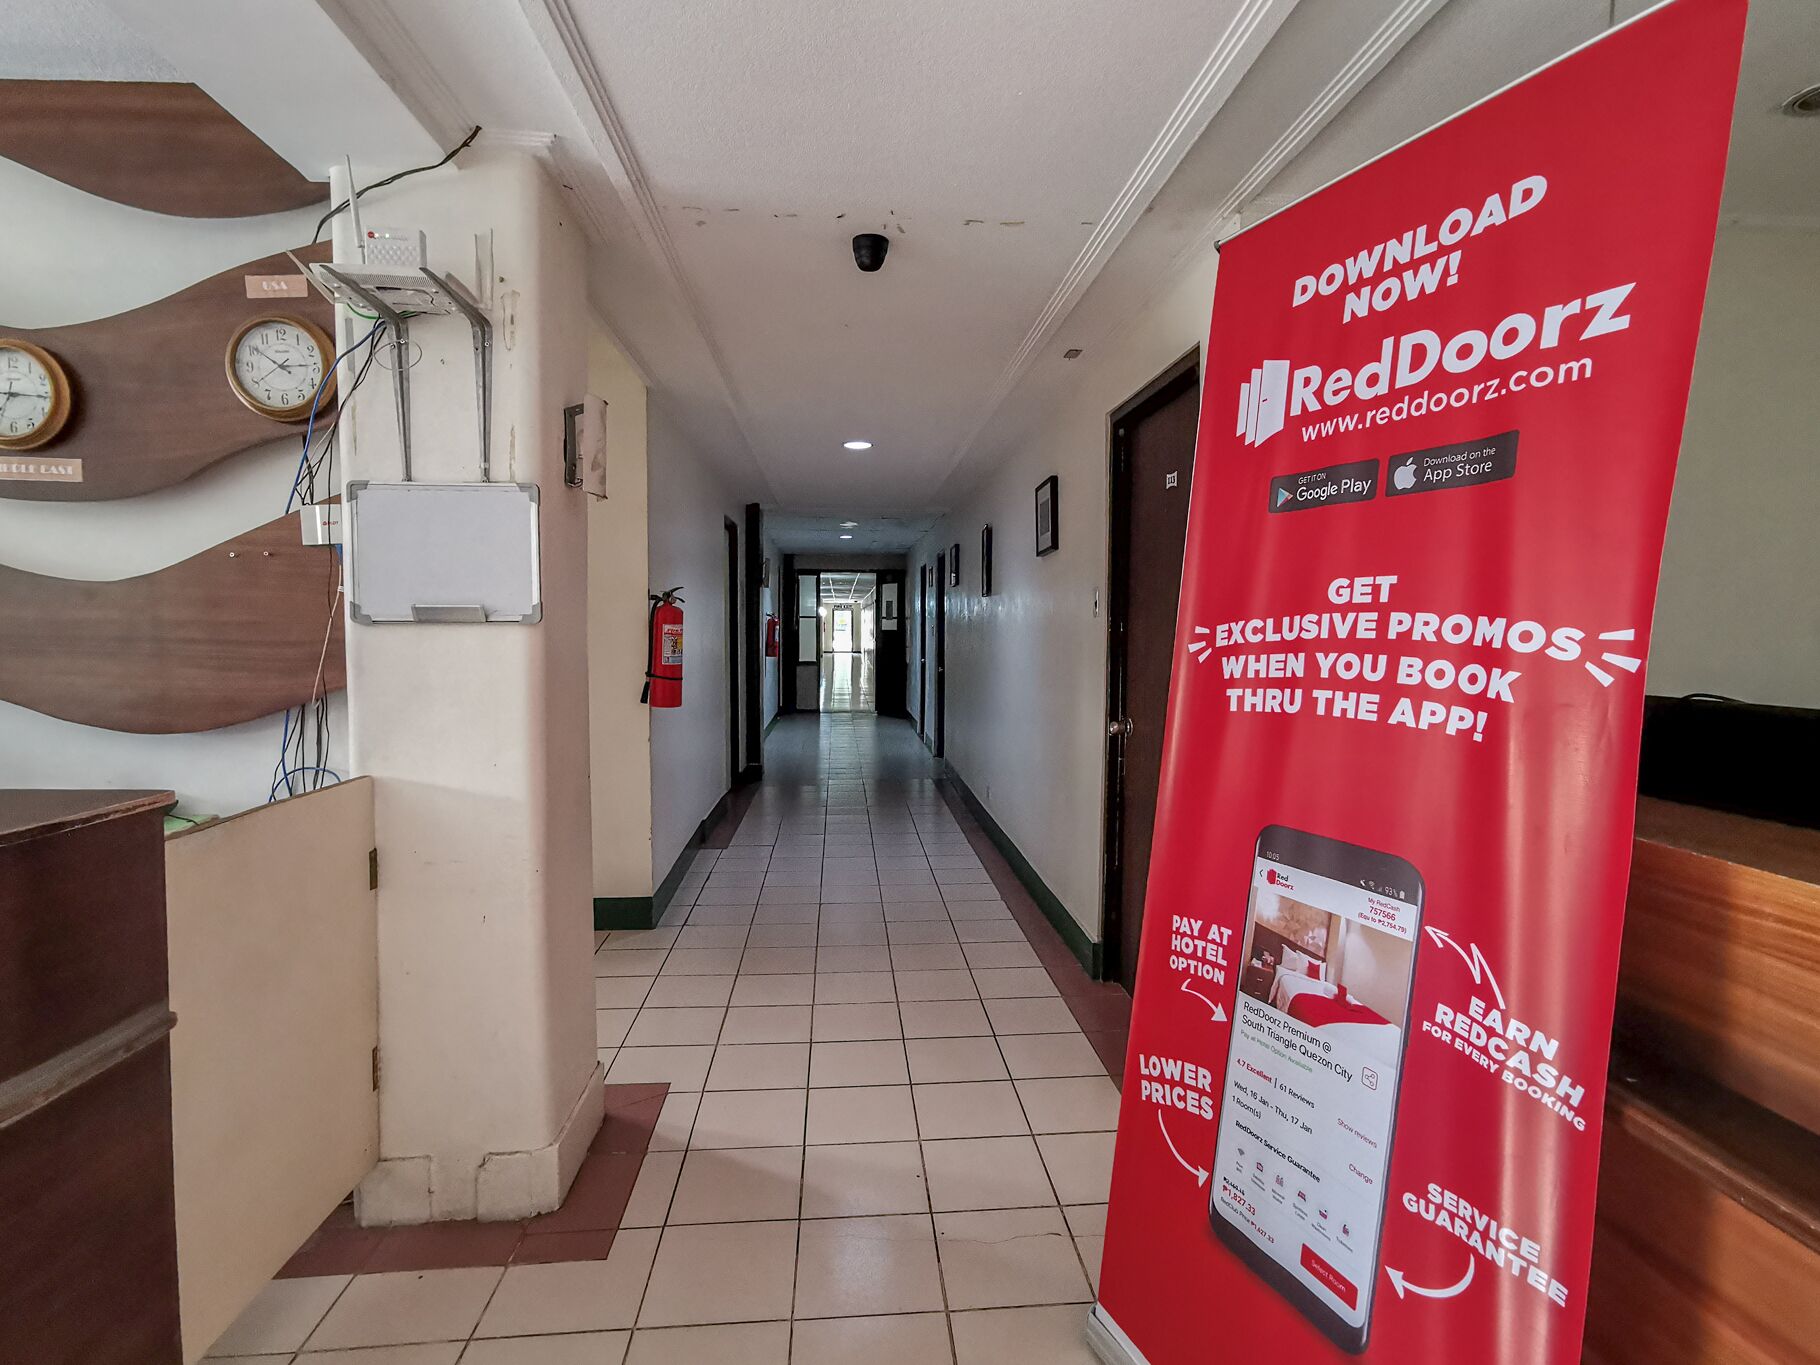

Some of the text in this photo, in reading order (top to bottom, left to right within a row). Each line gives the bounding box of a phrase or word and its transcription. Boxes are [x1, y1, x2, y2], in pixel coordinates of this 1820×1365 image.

[1292, 175, 1548, 308] DOWNLOAD
[262, 280, 288, 291] USA
[1343, 250, 1462, 324] NOW!
[275, 328, 287, 341] 12
[1290, 282, 1638, 417] RedDoorz
[264, 388, 272, 401] 7
[281, 392, 289, 406] 6
[1301, 357, 1593, 442] www.reddoorz.com
[1423, 446, 1496, 467] Download on the
[1424, 460, 1493, 484] App Store
[1296, 477, 1372, 501] Google Play
[1298, 472, 1327, 485] GET IT ON
[1327, 575, 1398, 605] GET
[1215, 612, 1587, 661] EXCLUSIVE PROMOS
[1221, 653, 1522, 704] WHEN YOU BOOK
[1226, 688, 1489, 743] THRU THE APP!
[1266, 851, 1280, 861] 10:05
[1276, 879, 1295, 891] Doorz
[1277, 872, 1289, 882] Red
[1369, 905, 1396, 921] 757566
[1376, 899, 1401, 912] RedCash
[1172, 914, 1232, 946] PAY AT
[1171, 934, 1228, 967] HOTEL
[1169, 955, 1225, 986] OPTION
[1243, 1001, 1332, 1053] RedDoorz Premium @
[1469, 995, 1560, 1061] EARN
[1242, 1014, 1353, 1083] South Triangle Quezon City
[1435, 1002, 1585, 1108] REDCASH
[1139, 1053, 1212, 1093] LOWER
[1246, 1063, 1272, 1083] Excellent
[1279, 1083, 1287, 1093] 61
[1288, 1088, 1315, 1109] Reviews
[1422, 1020, 1587, 1131] FOR EVERY BOOKING
[1140, 1079, 1214, 1121] PRICES
[1233, 1080, 1249, 1095] Wed,
[1250, 1090, 1258, 1100] 16
[1258, 1095, 1270, 1108] Jan
[1275, 1105, 1289, 1122] Thu,
[1290, 1115, 1299, 1126] 17
[1299, 1121, 1313, 1135] Jan
[1235, 1097, 1262, 1120] Room(s)
[1337, 1117, 1377, 1149] Show reviews
[1235, 1119, 1264, 1145] RedDoorz
[1263, 1139, 1286, 1160] Service
[1287, 1155, 1321, 1183] Guarantee
[1348, 1163, 1373, 1185] Change
[1427, 1182, 1541, 1264] SERVICE
[1402, 1192, 1569, 1308] GUARANTEE
[1311, 1259, 1346, 1292] Select Room
